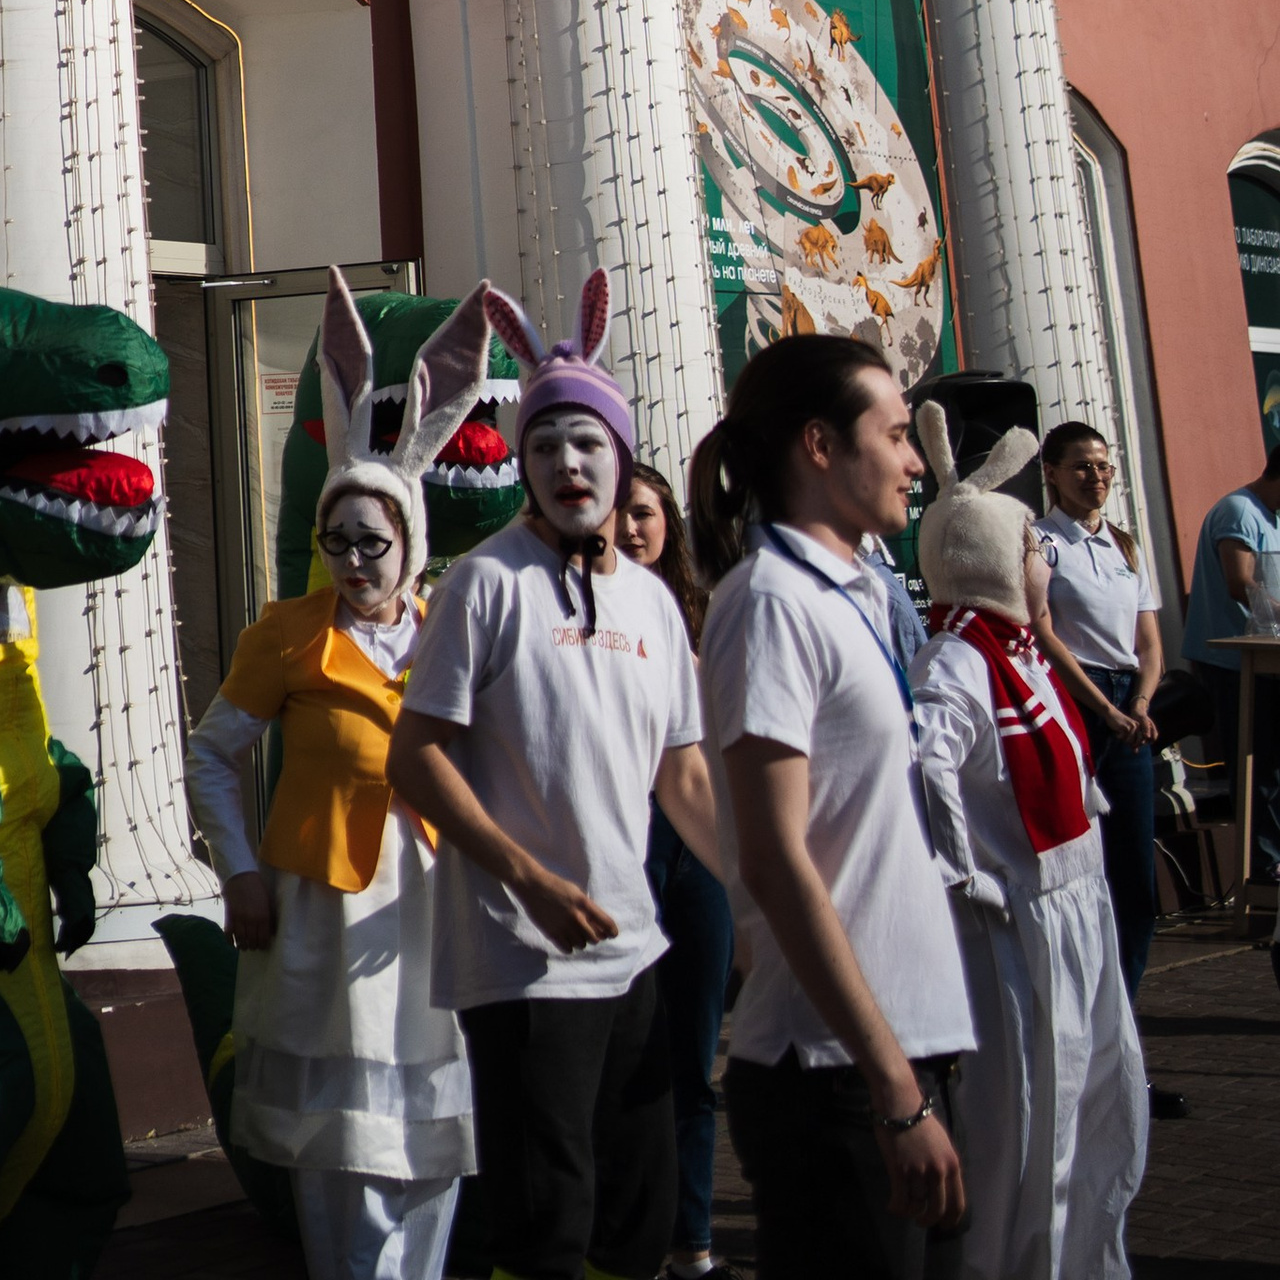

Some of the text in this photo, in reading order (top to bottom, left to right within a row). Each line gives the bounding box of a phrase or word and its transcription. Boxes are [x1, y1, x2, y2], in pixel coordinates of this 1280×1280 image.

[1241, 227, 1280, 248] ЛАБОРАТОР
[727, 242, 768, 261] древний
[597, 629, 631, 653] ЗДЕСЬ
